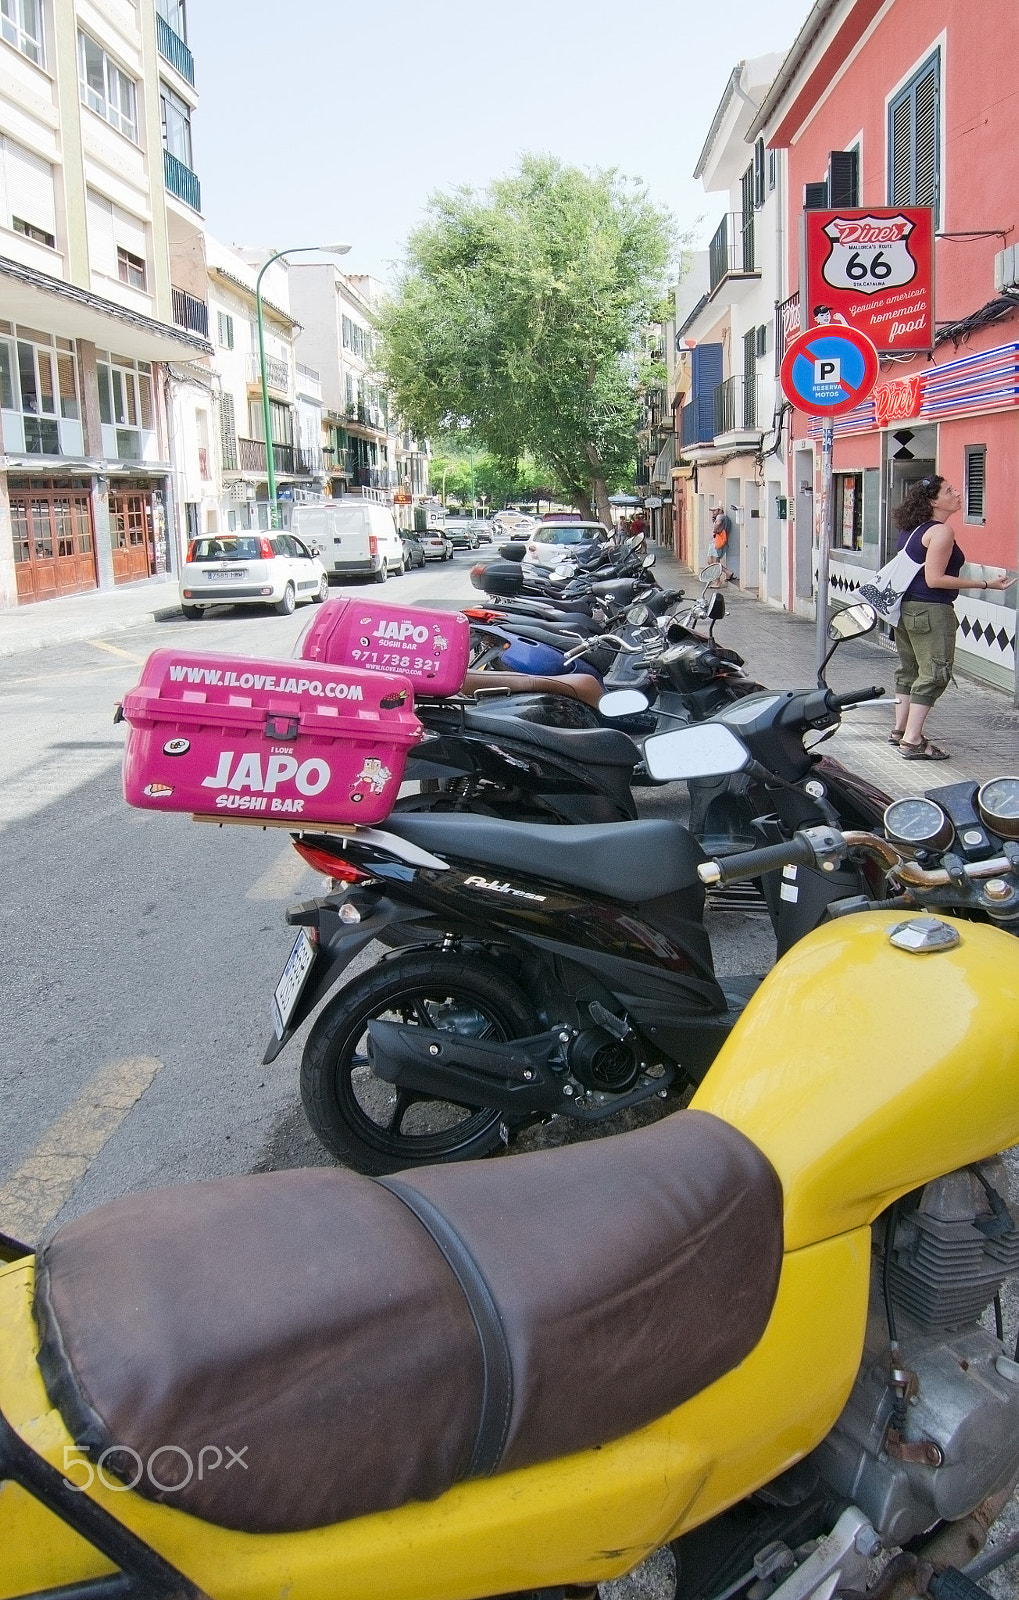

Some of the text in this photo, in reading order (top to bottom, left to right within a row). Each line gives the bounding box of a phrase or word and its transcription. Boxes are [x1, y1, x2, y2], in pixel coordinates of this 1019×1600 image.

[836, 223, 906, 246] Diner
[845, 251, 892, 280] 66
[848, 287, 927, 317] Genuine american
[869, 302, 927, 325] homemade
[889, 314, 927, 343] food
[820, 362, 835, 381] P
[812, 384, 842, 392] RESERVA
[873, 376, 920, 427] Diner
[372, 620, 429, 643] JAPO
[378, 639, 417, 650] SUSHI BAR
[351, 649, 440, 671] 971 738 321
[169, 665, 364, 701] WWW.ILOVEJAPO.COM
[201, 751, 331, 796] JAPO
[216, 794, 304, 813] SUSHI BAR
[463, 875, 547, 902] Address
